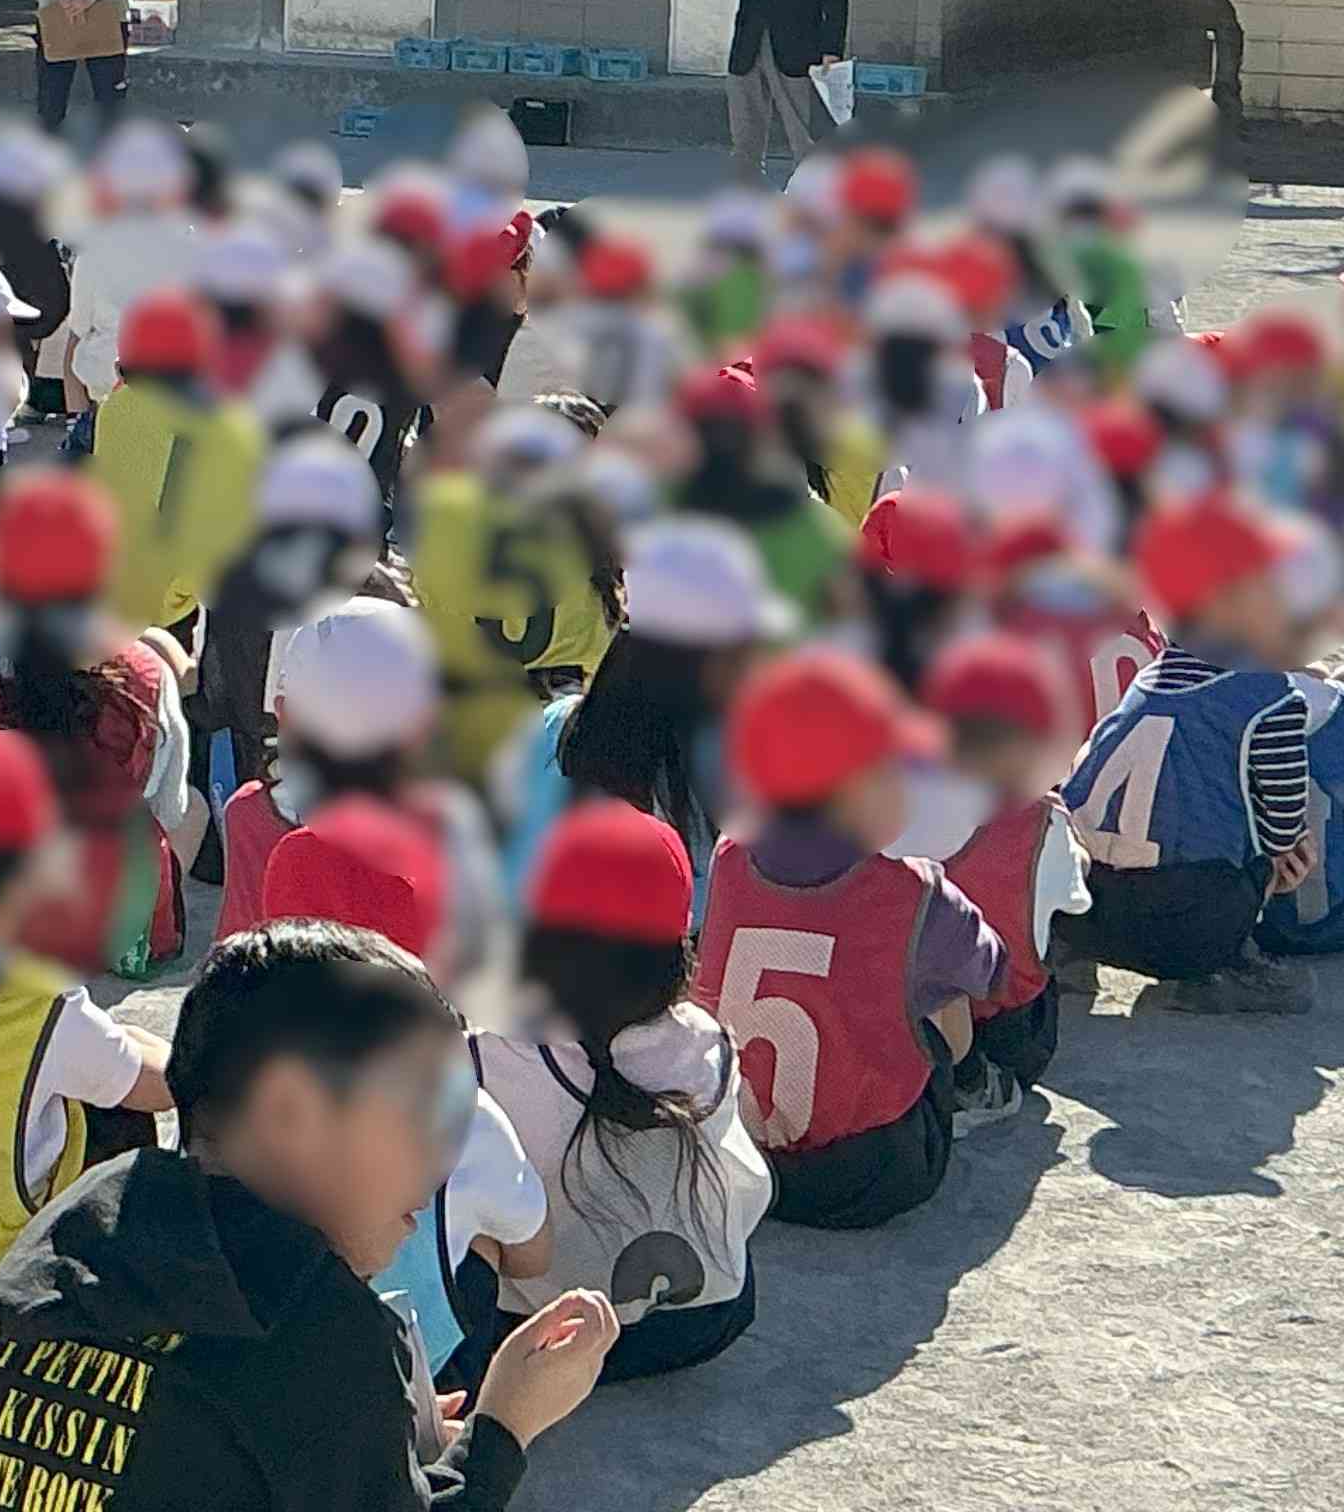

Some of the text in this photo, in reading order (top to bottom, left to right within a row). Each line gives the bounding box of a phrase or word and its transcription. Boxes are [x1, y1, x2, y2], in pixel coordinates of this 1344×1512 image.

[1068, 714, 1177, 870] 4
[717, 927, 836, 1150] 5
[22, 1340, 154, 1414] PETTIN
